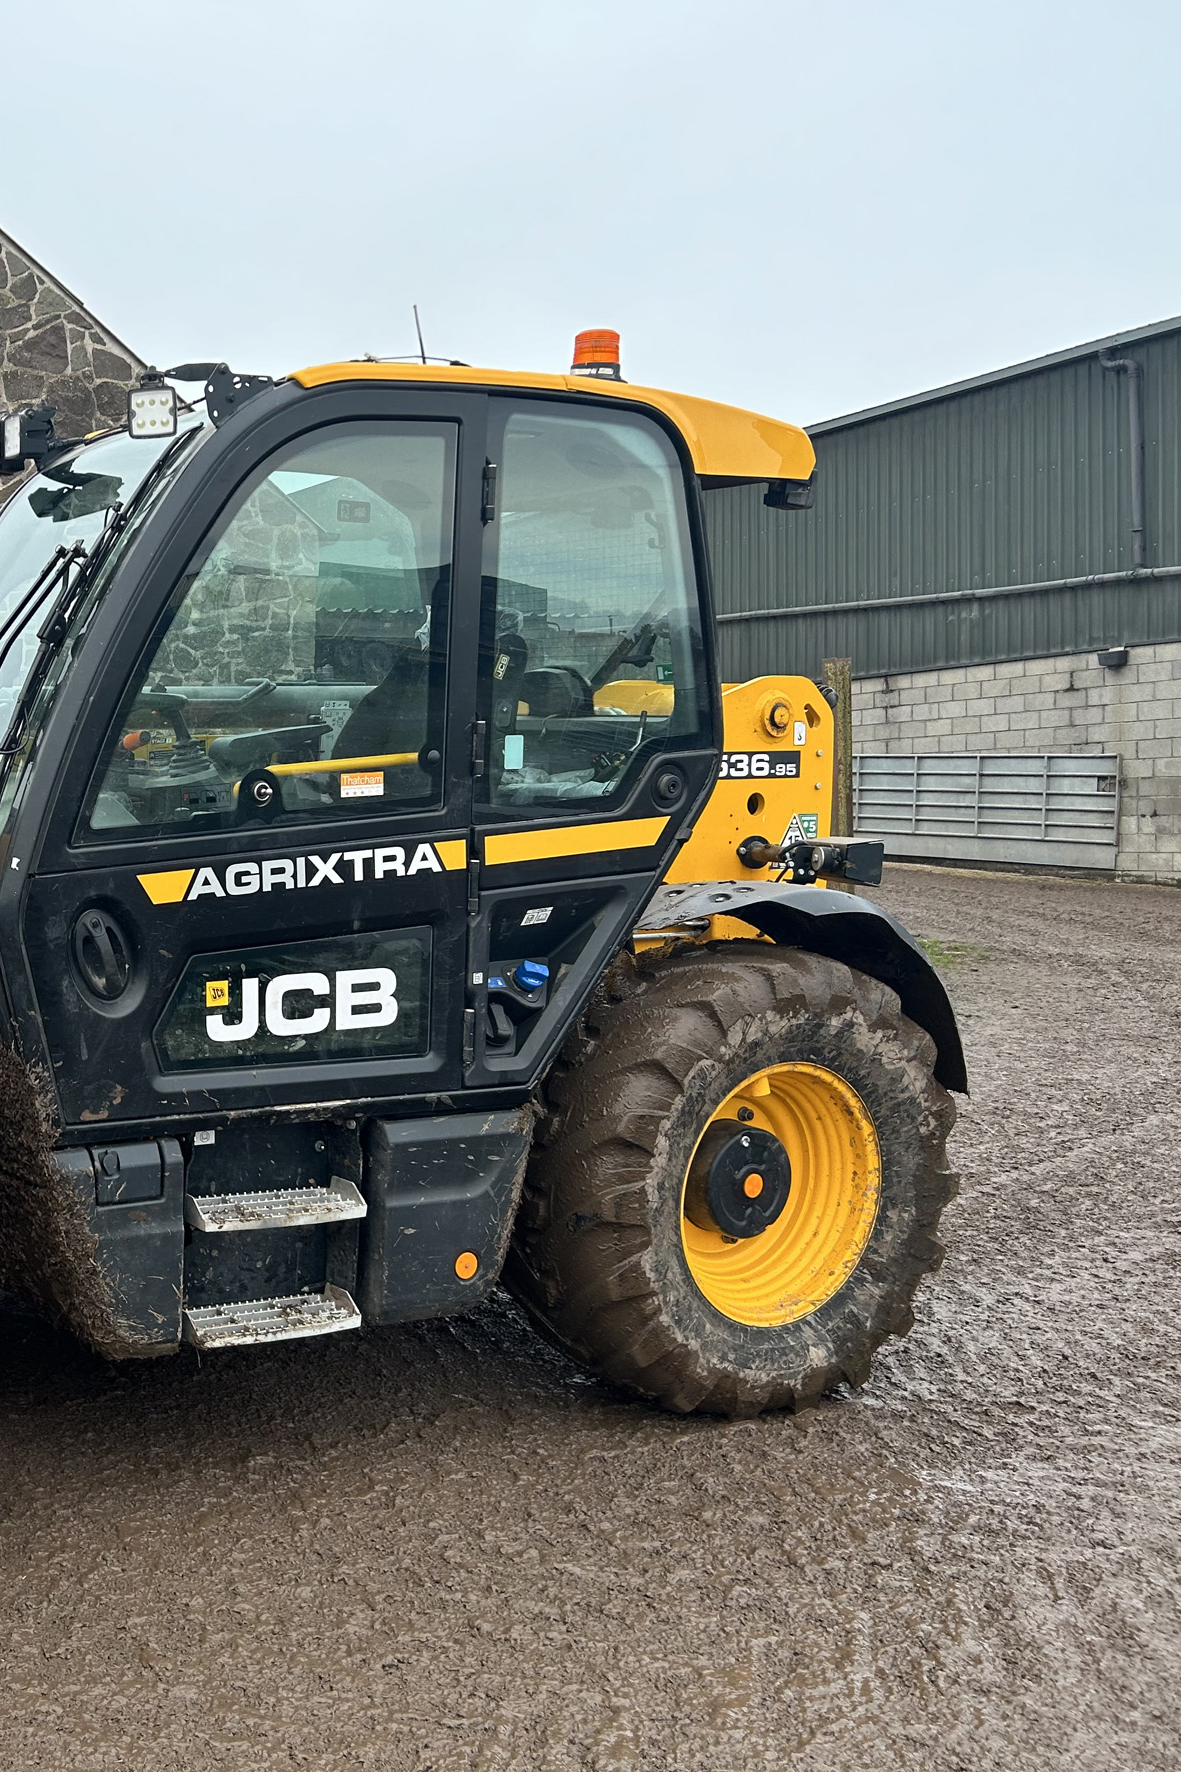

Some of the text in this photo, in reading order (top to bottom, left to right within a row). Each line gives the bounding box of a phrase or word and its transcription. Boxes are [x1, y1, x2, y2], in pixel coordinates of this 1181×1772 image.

[496, 656, 508, 678] JCB
[342, 774, 382, 786] Thatcham
[187, 843, 443, 900] AGRIXTRA
[211, 988, 225, 999] JCB
[206, 968, 399, 1042] JCB
